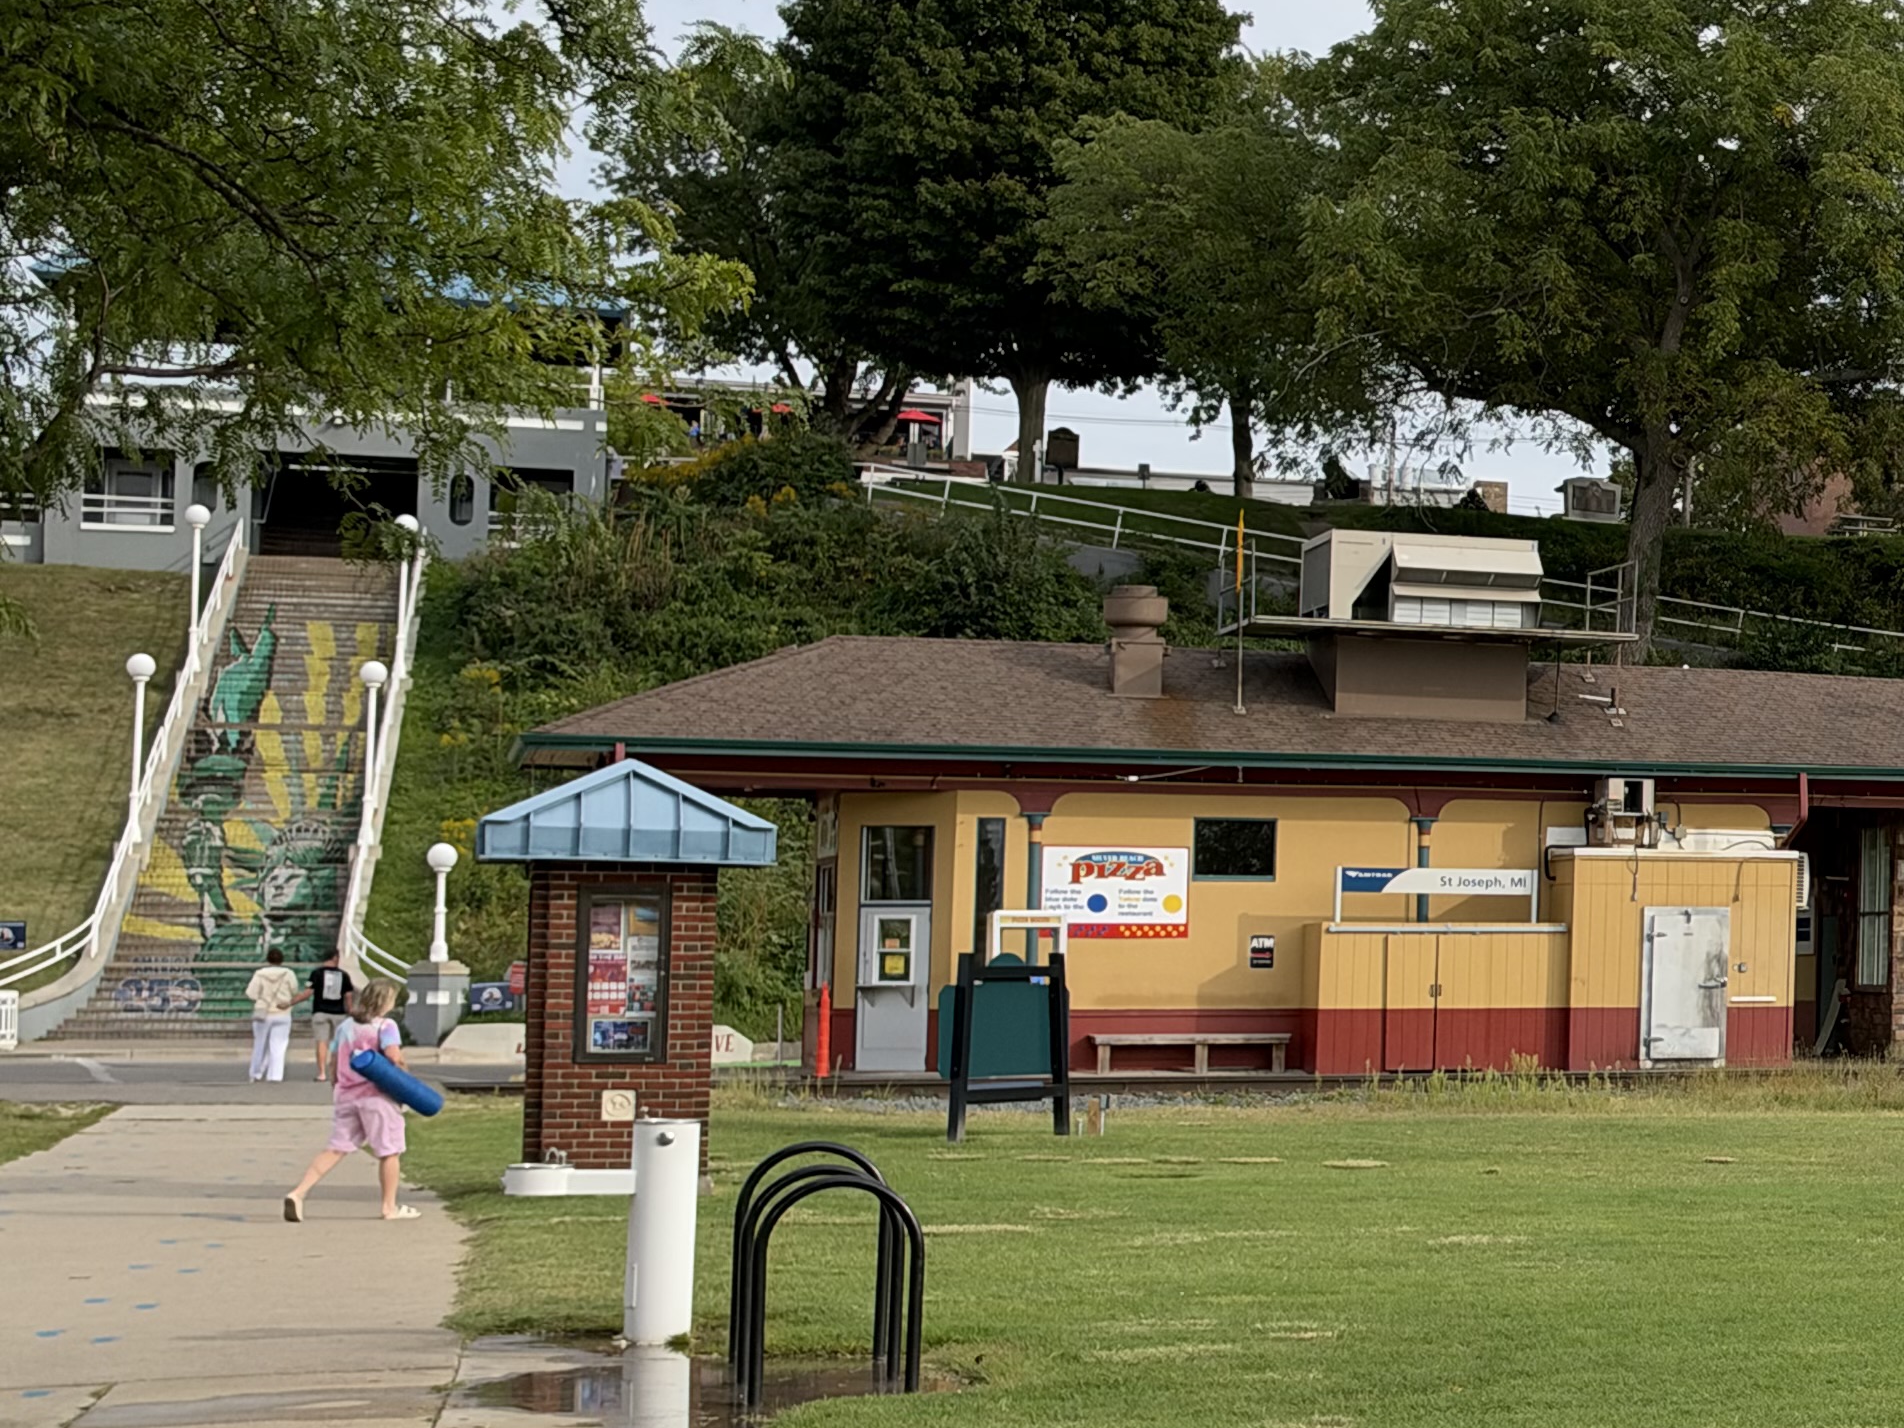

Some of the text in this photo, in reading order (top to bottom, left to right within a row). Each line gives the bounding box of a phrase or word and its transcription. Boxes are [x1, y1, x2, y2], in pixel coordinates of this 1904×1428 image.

[1068, 860, 1167, 885] pizza
[1440, 875, 1527, 890] St Joseph, MI
[1250, 937, 1275, 949] ATM
[112, 976, 204, 1013] 250
